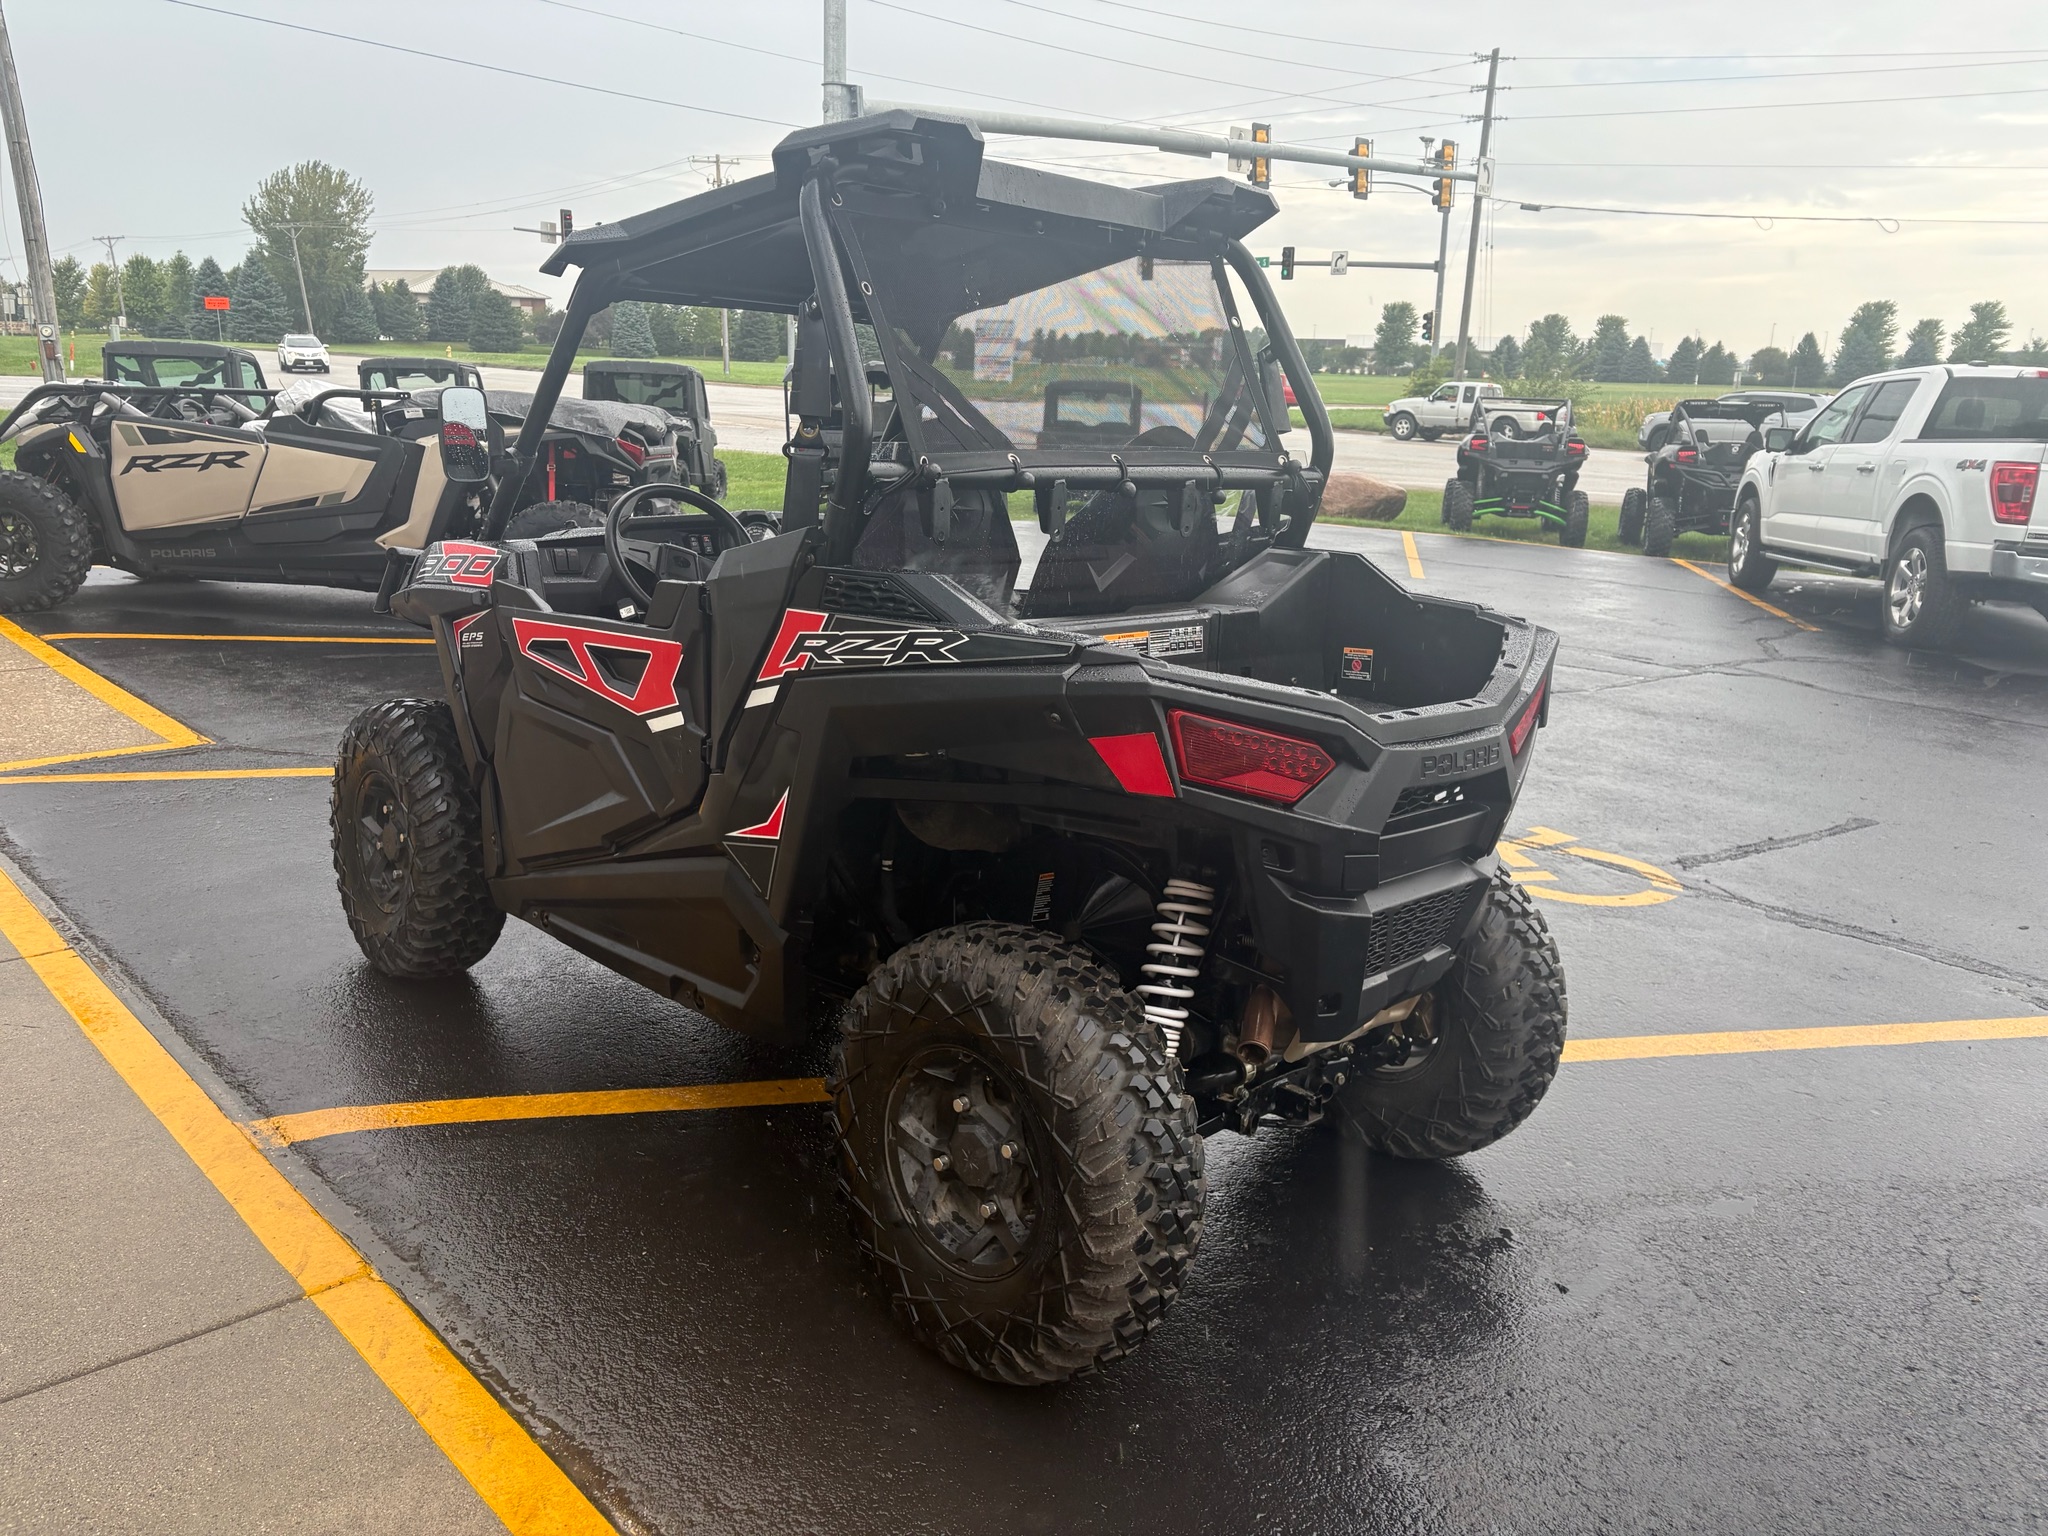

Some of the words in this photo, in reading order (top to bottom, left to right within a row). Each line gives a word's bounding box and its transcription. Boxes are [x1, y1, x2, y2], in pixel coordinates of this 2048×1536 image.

[119, 450, 250, 476] RZR
[150, 548, 217, 559] POLARIS
[462, 631, 484, 642] EPS
[777, 628, 970, 668] RZR
[1420, 743, 1500, 779] POLARIS
